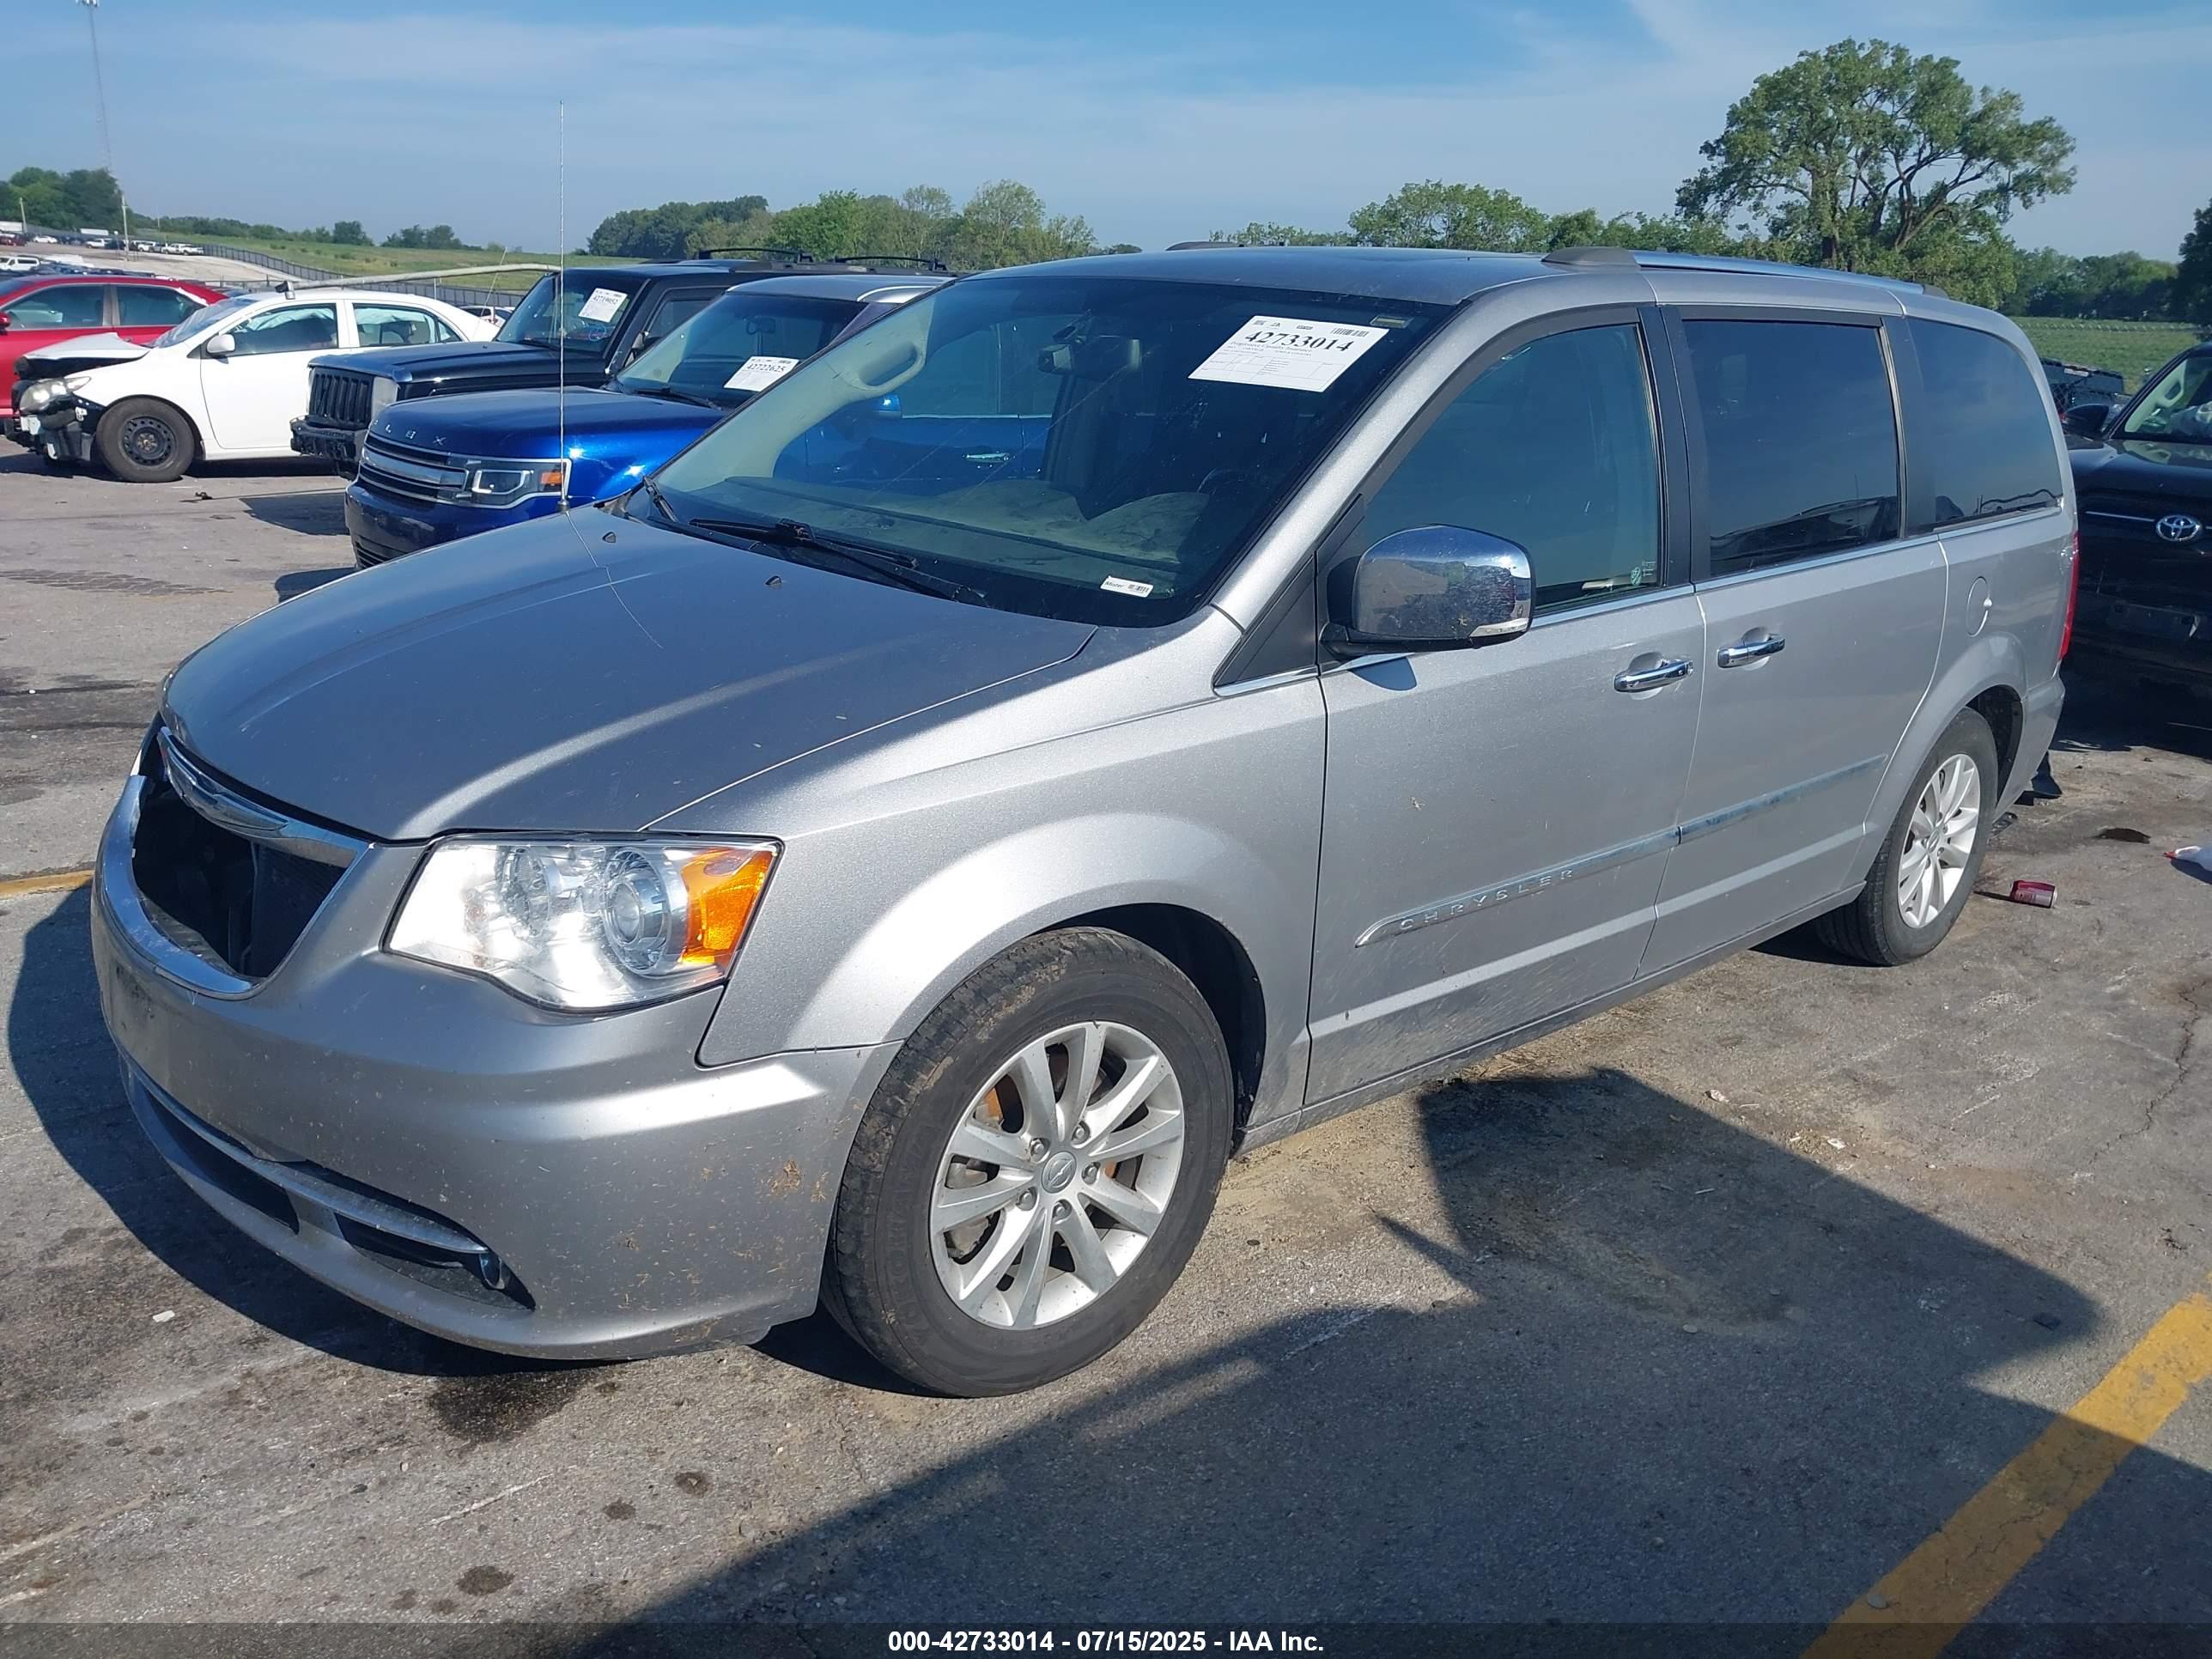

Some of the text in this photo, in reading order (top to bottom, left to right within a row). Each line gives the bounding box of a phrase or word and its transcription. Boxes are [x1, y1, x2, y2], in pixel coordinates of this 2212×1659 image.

[1244, 331, 1354, 351] 42733014
[746, 363, 787, 373] 42722625
[1401, 869, 1573, 931] CHRYSLER
